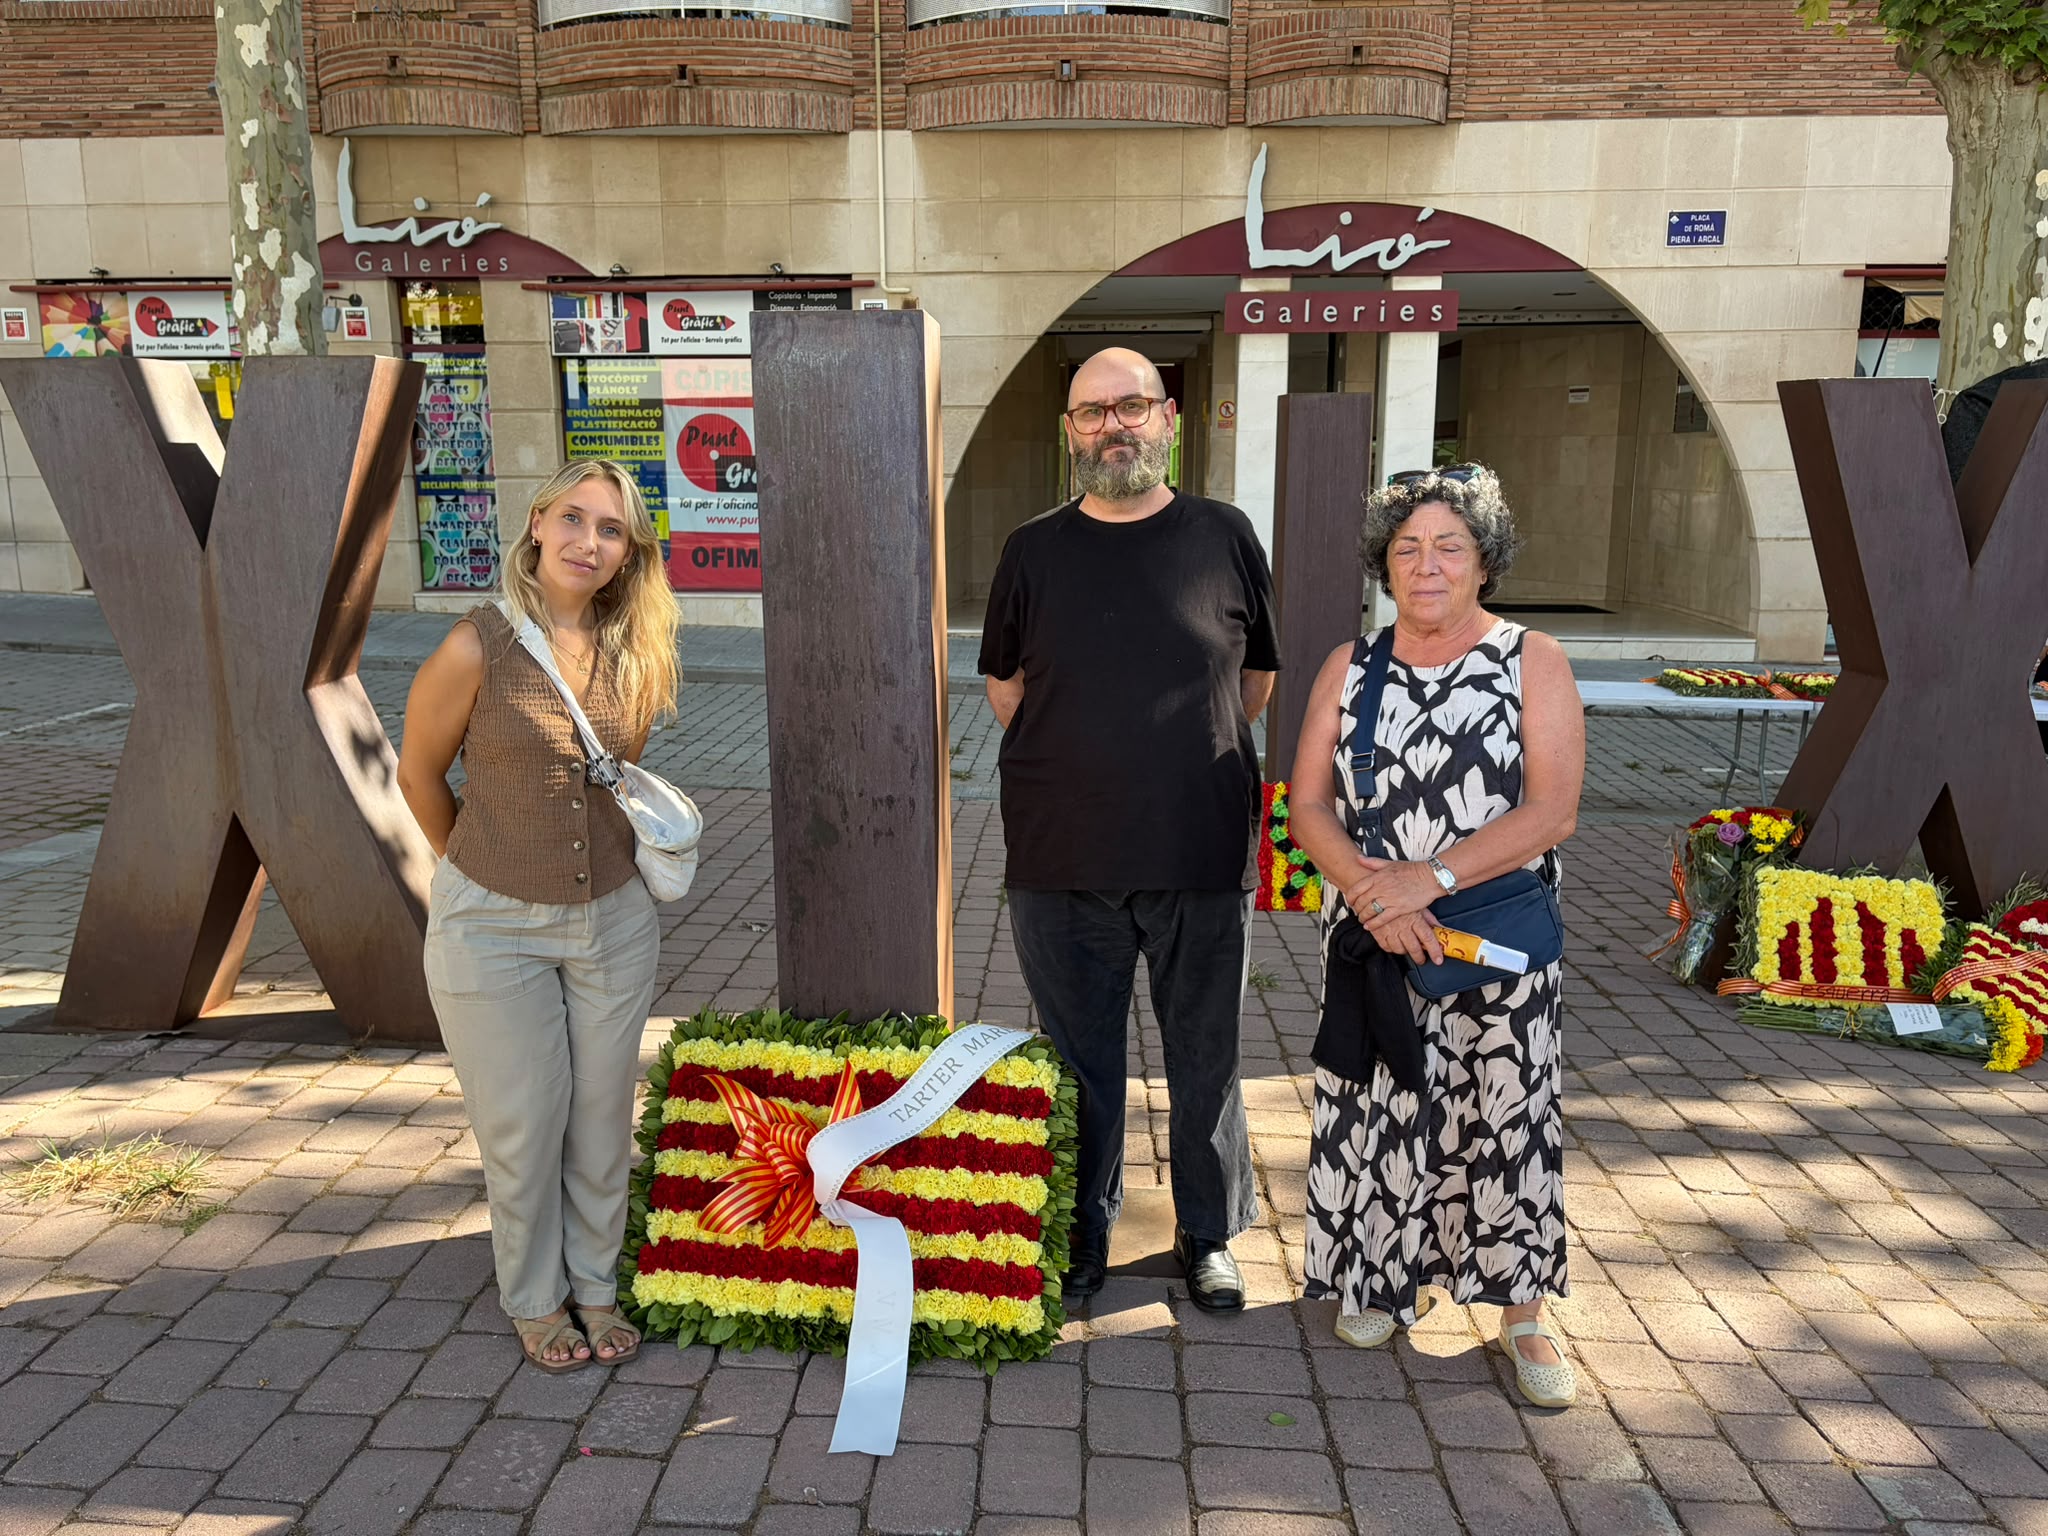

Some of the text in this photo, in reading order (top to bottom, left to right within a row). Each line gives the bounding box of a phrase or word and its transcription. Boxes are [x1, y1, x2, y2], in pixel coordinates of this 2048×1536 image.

[1670, 235, 1690, 243] PIERA
[1698, 235, 1720, 243] ARCAL
[355, 251, 508, 272] Galeries
[807, 291, 838, 301] Impremta
[139, 304, 165, 314] Punt
[667, 304, 689, 313] Punt
[1243, 298, 1443, 324] Galeries
[157, 318, 195, 336] Gràfic
[681, 316, 714, 330] Gràfic
[577, 372, 649, 384] FOTOCÒPIES
[433, 385, 469, 395] LONES
[588, 398, 640, 406] PLOTTER
[566, 408, 662, 419] ENQUADERNACIÓ
[429, 422, 481, 431] POSTERS
[572, 419, 658, 429] PLASTIFICACIÓ
[571, 435, 660, 446] CONSUMIBLES
[686, 425, 738, 447] Punt
[420, 480, 450, 489] RECLAM
[438, 503, 484, 512] GORRES
[680, 498, 692, 509] Tot
[694, 500, 713, 512] per
[440, 539, 490, 548] CLAUERS
[446, 573, 489, 582] REGALS
[1800, 985, 1890, 1002] esquerra
[888, 1056, 964, 1124] TARTER
